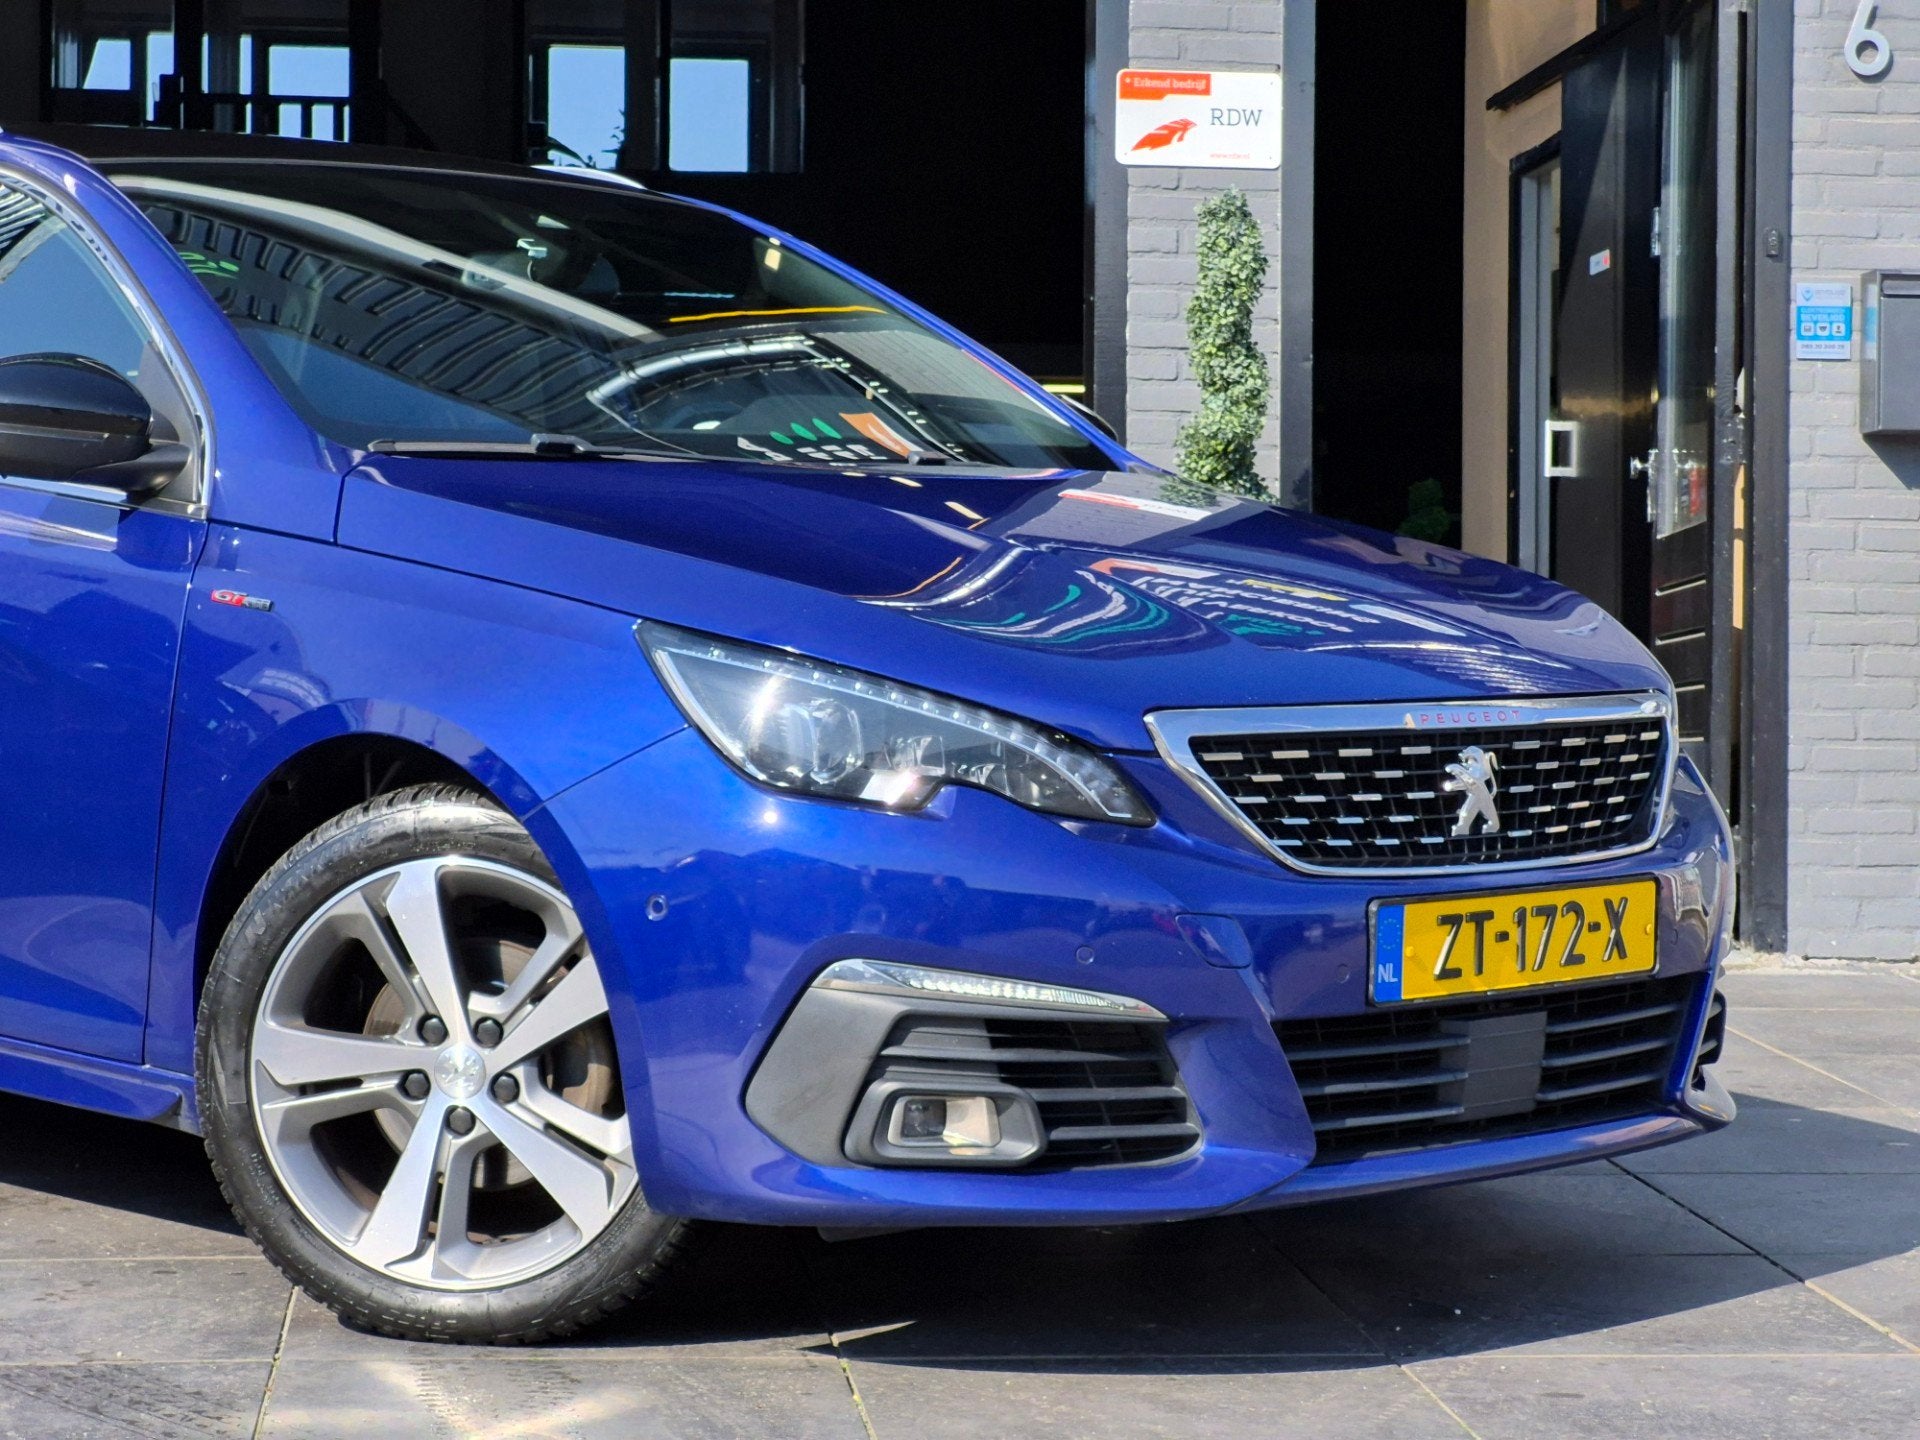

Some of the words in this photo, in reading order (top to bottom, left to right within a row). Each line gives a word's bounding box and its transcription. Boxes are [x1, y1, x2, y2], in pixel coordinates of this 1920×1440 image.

[1844, 0, 1890, 76] 6
[1134, 78, 1170, 88] Erkend
[1173, 79, 1206, 90] bedrijf
[1210, 108, 1262, 126] RDW
[1420, 710, 1520, 725] PEUGEOT
[1433, 897, 1629, 981] ZT-172-X
[1377, 963, 1399, 983] NL
